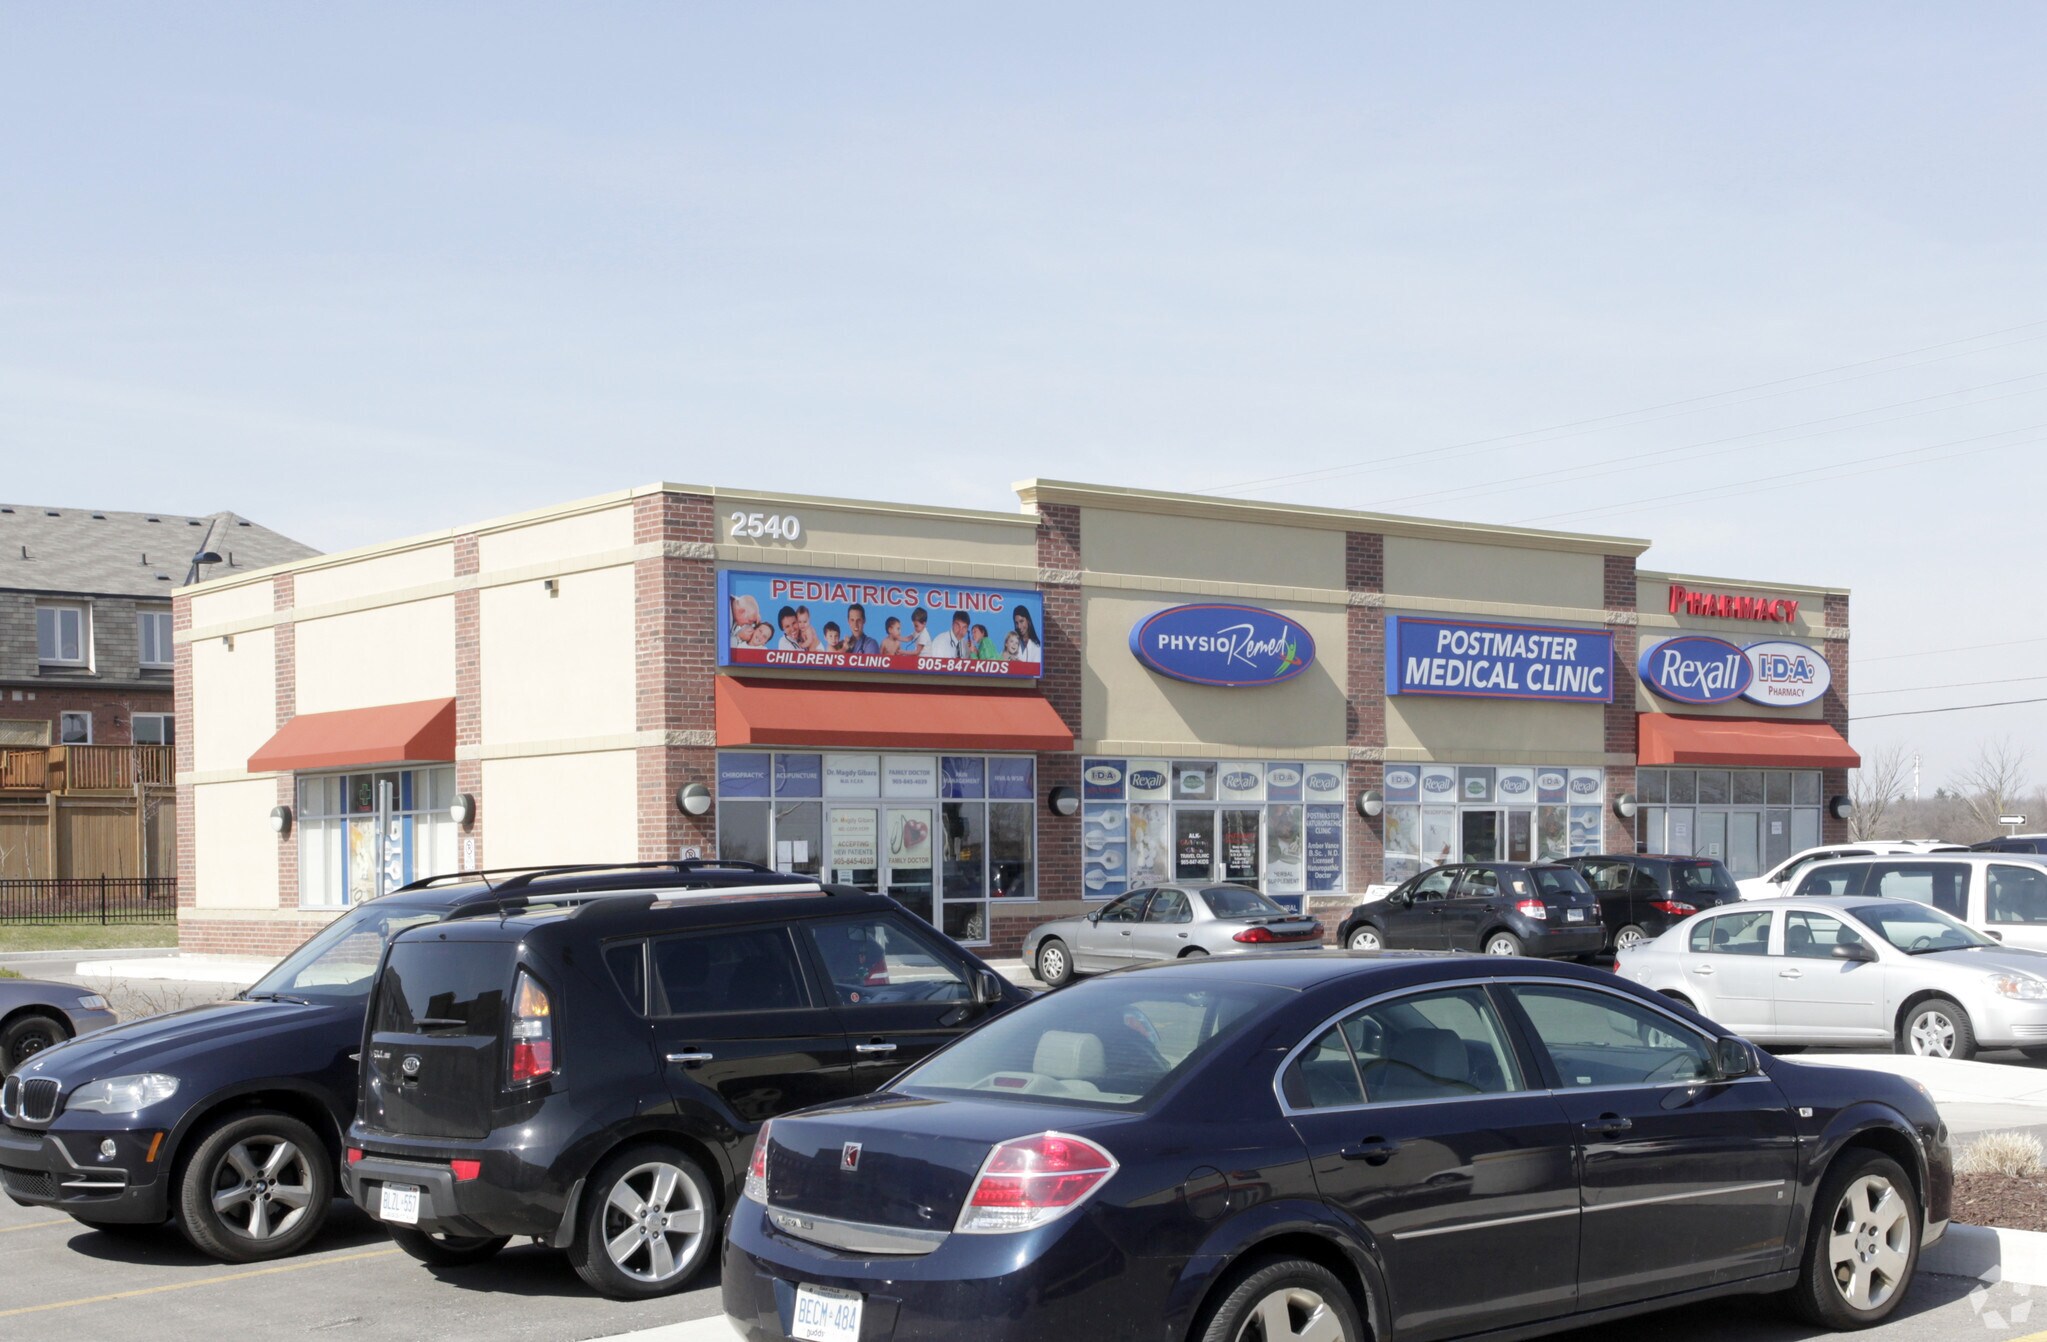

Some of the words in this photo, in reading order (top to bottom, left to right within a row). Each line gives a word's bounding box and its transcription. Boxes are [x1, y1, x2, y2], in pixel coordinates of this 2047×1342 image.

[731, 511, 801, 541] 2540
[771, 578, 919, 607] PEDIATRICS
[926, 590, 1004, 613] CLINIC
[1669, 583, 1798, 624] PHARMACY
[1158, 634, 1229, 653] PHYSIO
[1217, 623, 1288, 669] Remed
[1437, 629, 1577, 661] POSTMASTER
[766, 651, 845, 667] CHILDREN'S
[849, 655, 891, 668] CLINIC
[917, 656, 1009, 675] 905-847-KIDS
[1405, 657, 1519, 689] MEDICAL
[1526, 663, 1605, 694] CLINIC
[1661, 649, 1740, 698] Rexall
[1768, 685, 1805, 697] PHARMACY
[776, 772, 817, 780] ACUPUNCTURE
[1132, 773, 1163, 789] Rexall
[1226, 775, 1255, 790] Rexall
[1309, 775, 1337, 790] Rexall
[1425, 778, 1450, 792] Rexall
[1503, 779, 1527, 793] Rexall
[1573, 780, 1596, 794] Rexall
[1307, 812, 1340, 820] POSTMASTER
[1308, 864, 1339, 872] Naturopathic
[834, 1304, 857, 1332] 484
